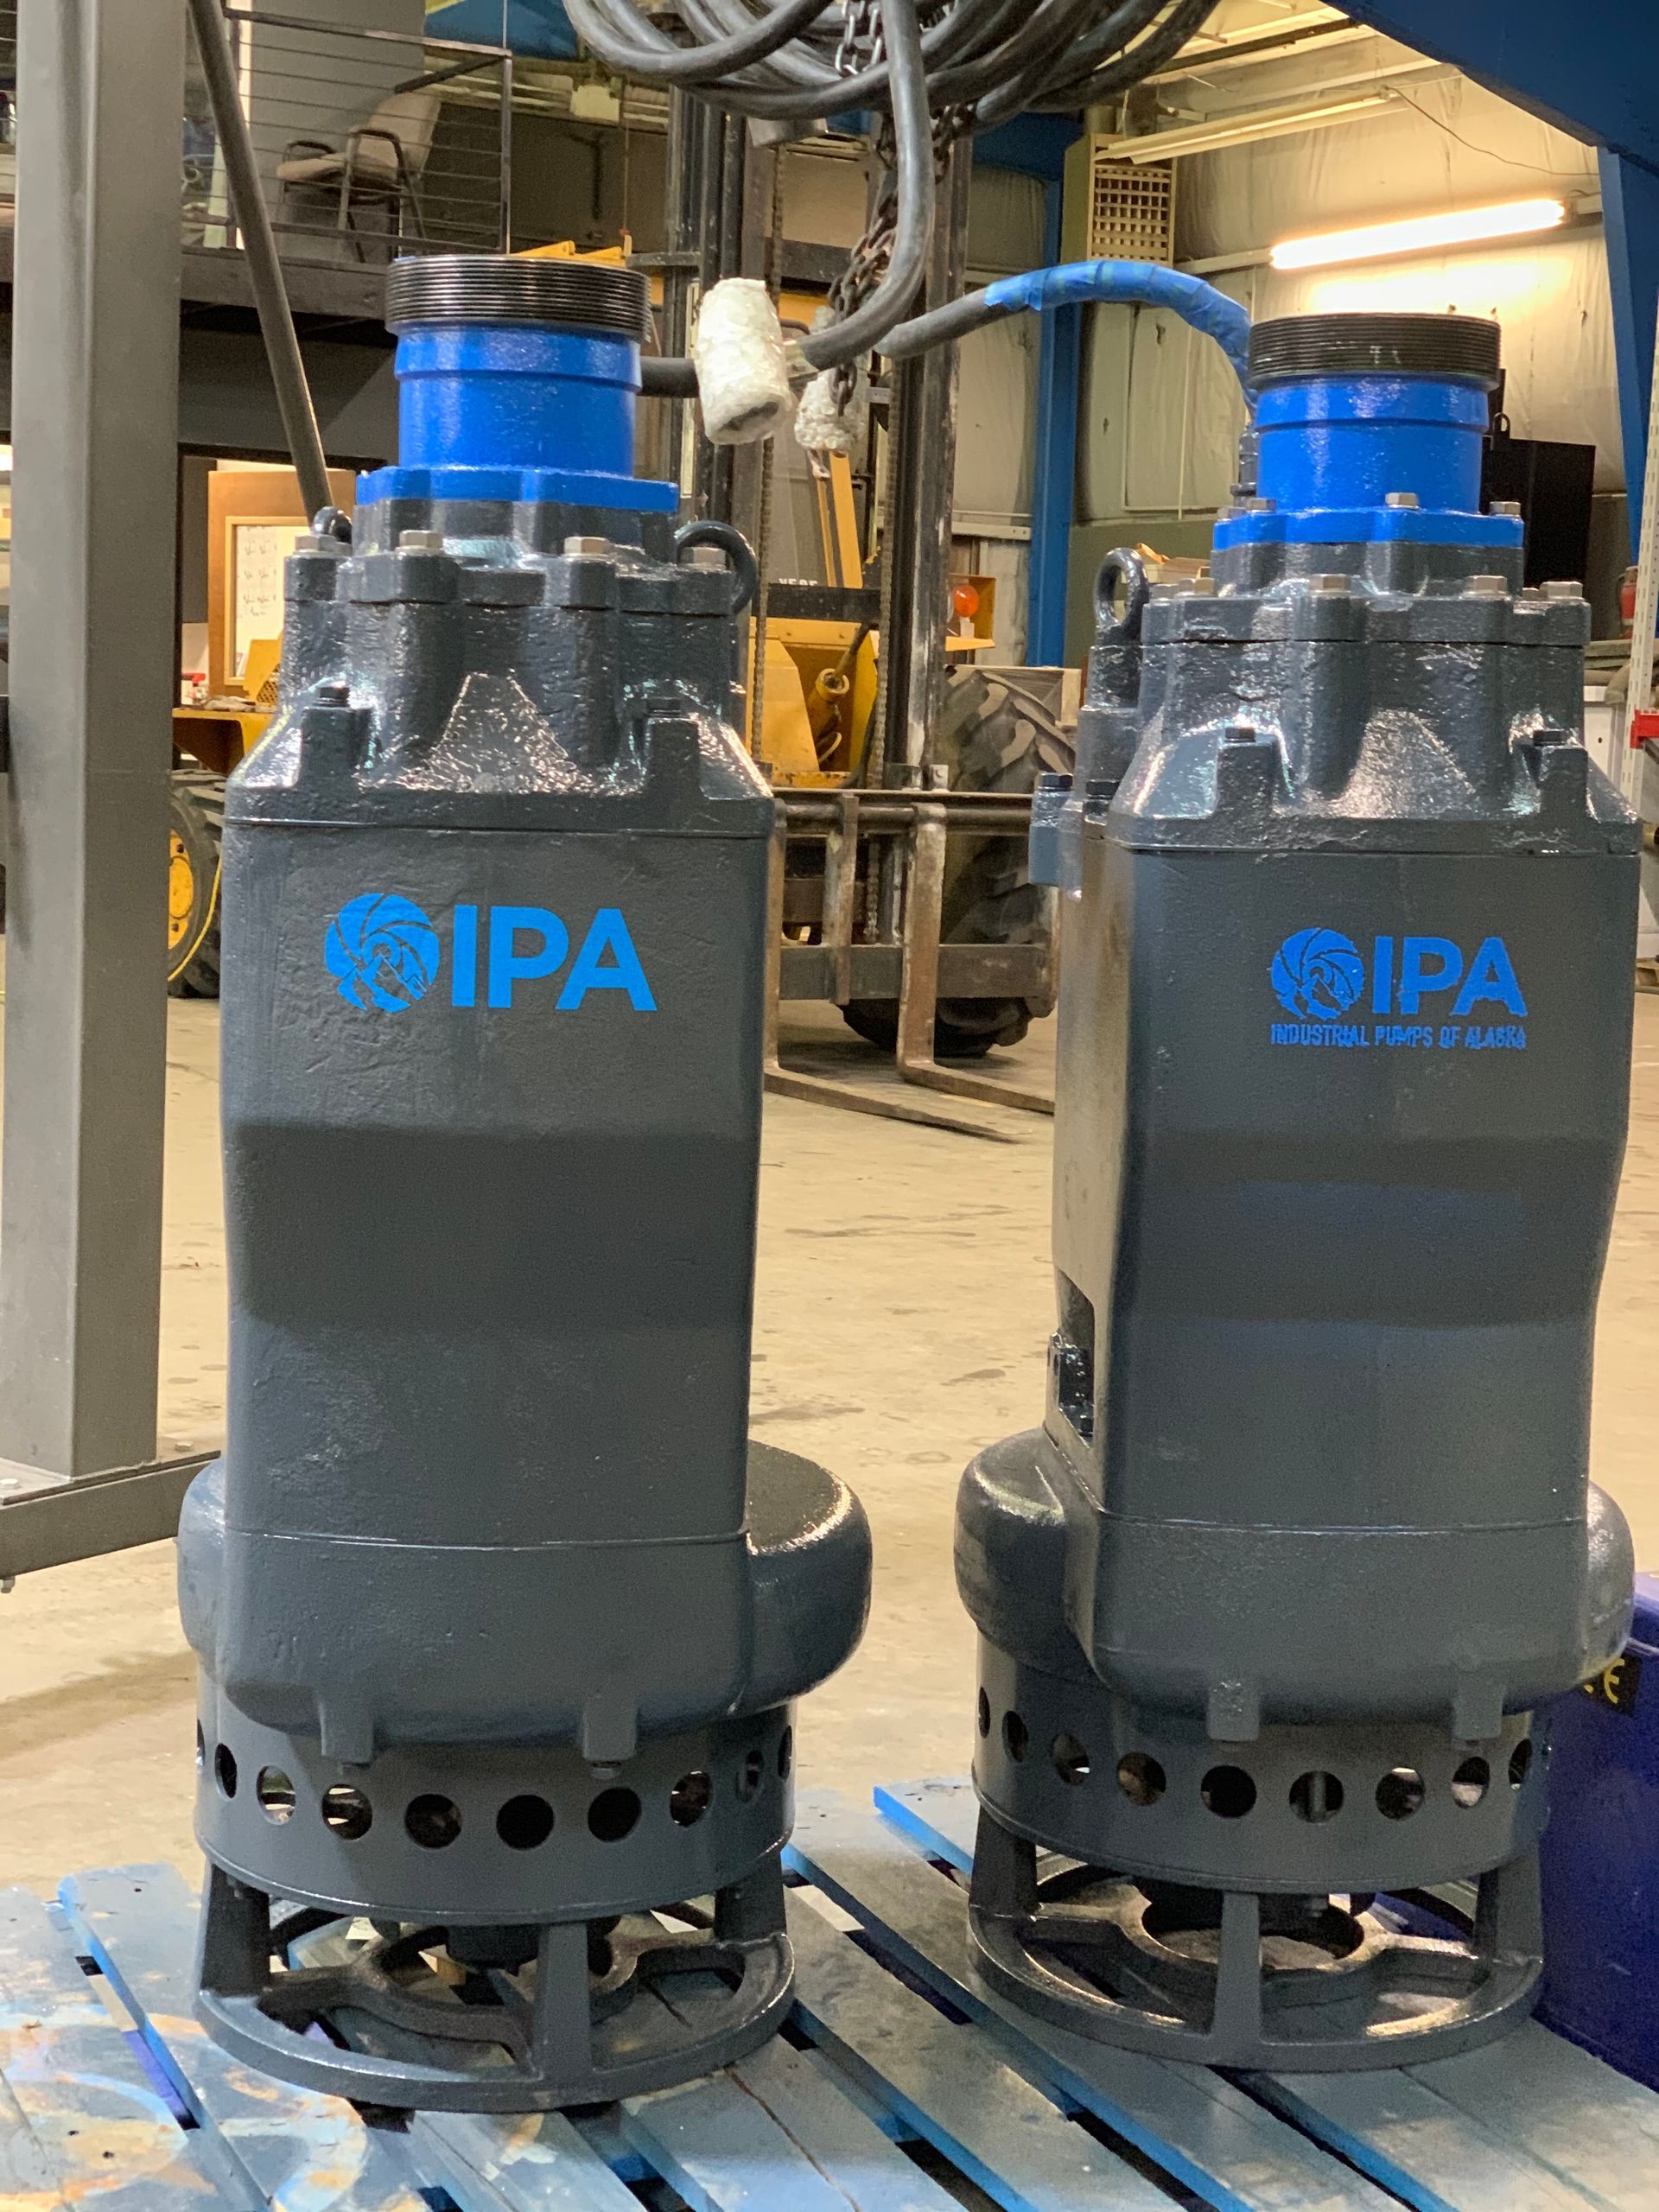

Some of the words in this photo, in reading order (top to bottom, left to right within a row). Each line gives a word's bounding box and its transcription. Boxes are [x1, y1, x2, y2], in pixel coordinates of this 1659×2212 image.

[452, 905, 658, 1011] IPA
[1372, 936, 1528, 1017] IPA
[1271, 1024, 1369, 1048] INDUSTRIAL
[1375, 1026, 1433, 1049] PUMPS
[1439, 1026, 1460, 1049] OF
[1465, 1025, 1526, 1050] ALASKA
